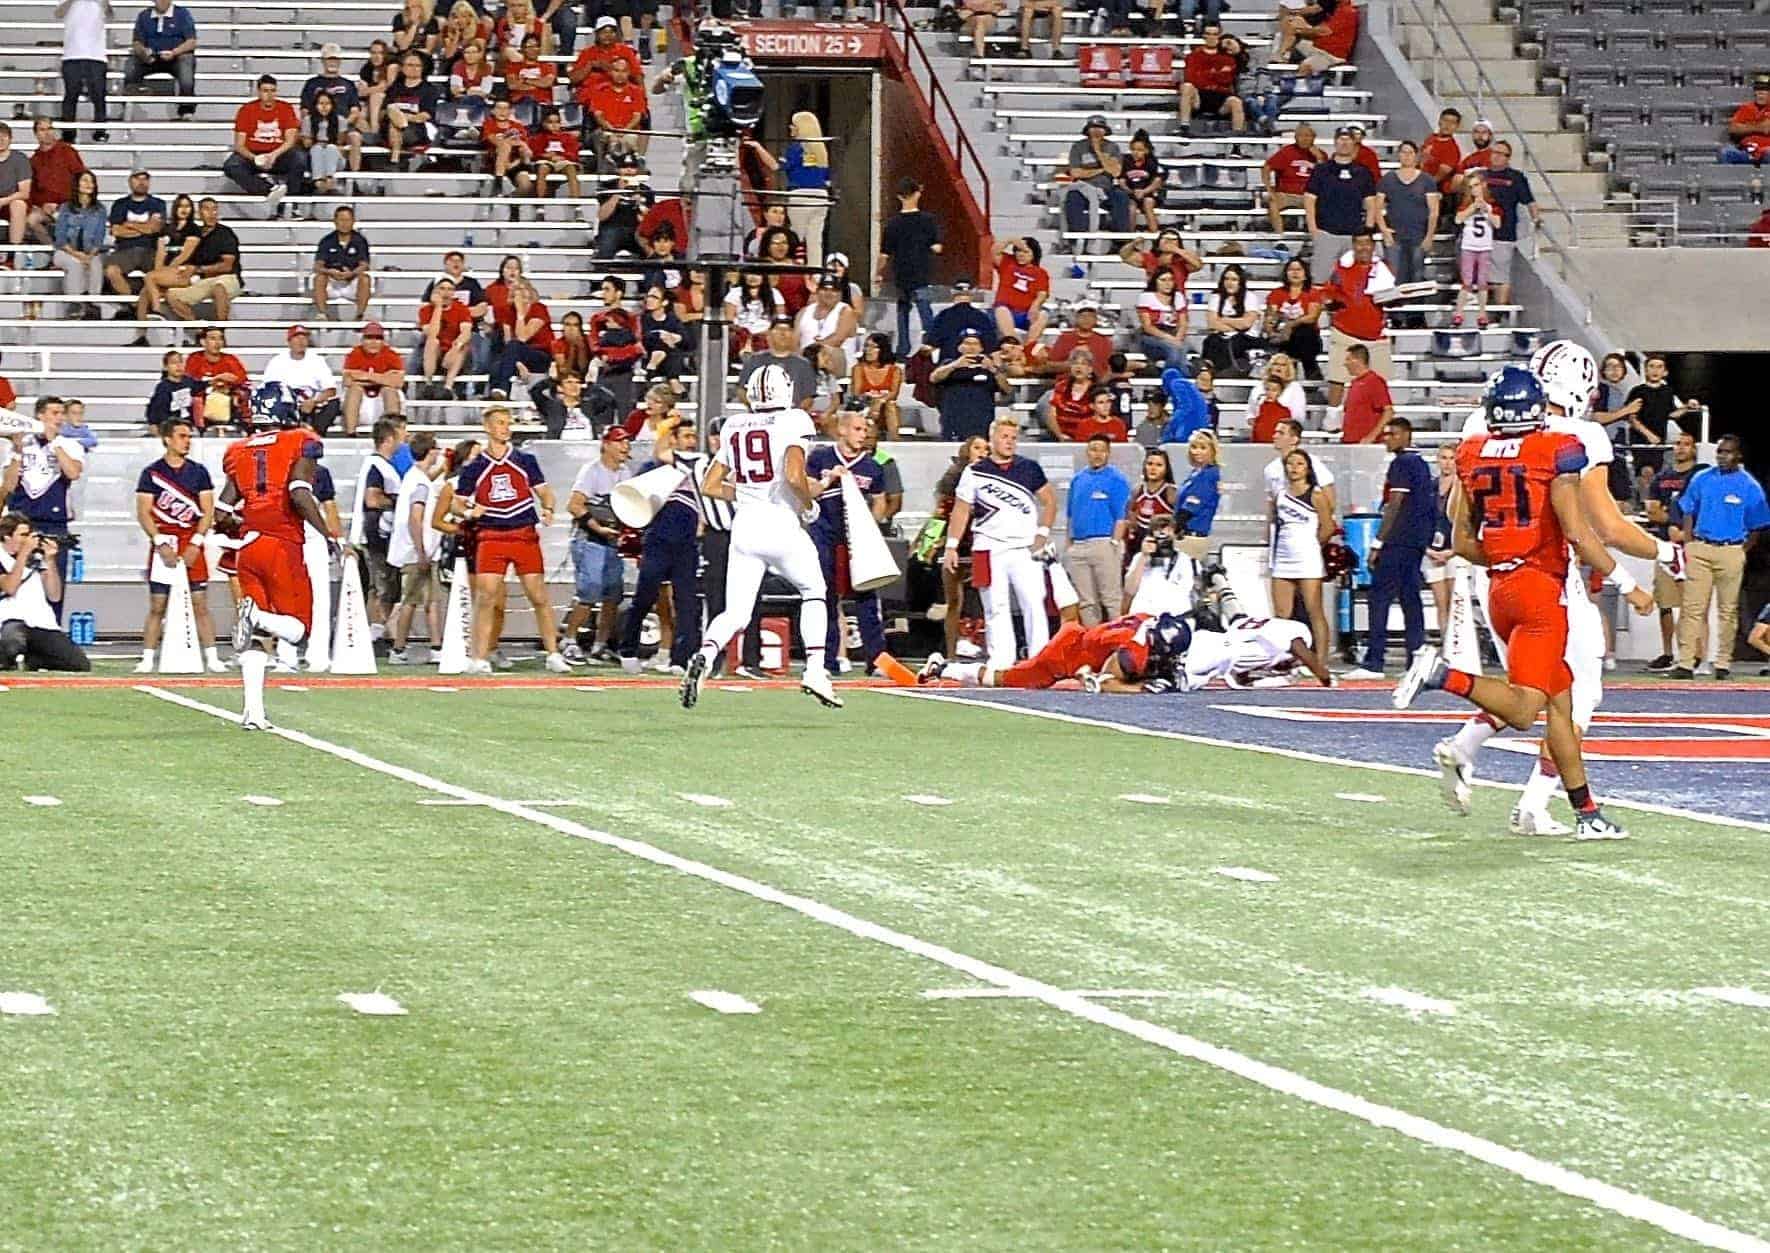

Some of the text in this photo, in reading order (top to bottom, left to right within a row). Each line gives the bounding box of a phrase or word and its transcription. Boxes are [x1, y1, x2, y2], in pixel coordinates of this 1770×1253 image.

[755, 34, 802, 54] SECTION
[824, 35, 845, 54] 25
[1472, 216, 1486, 238] 5
[253, 449, 267, 495] 1
[729, 430, 775, 484] 19
[1471, 464, 1532, 528] 21
